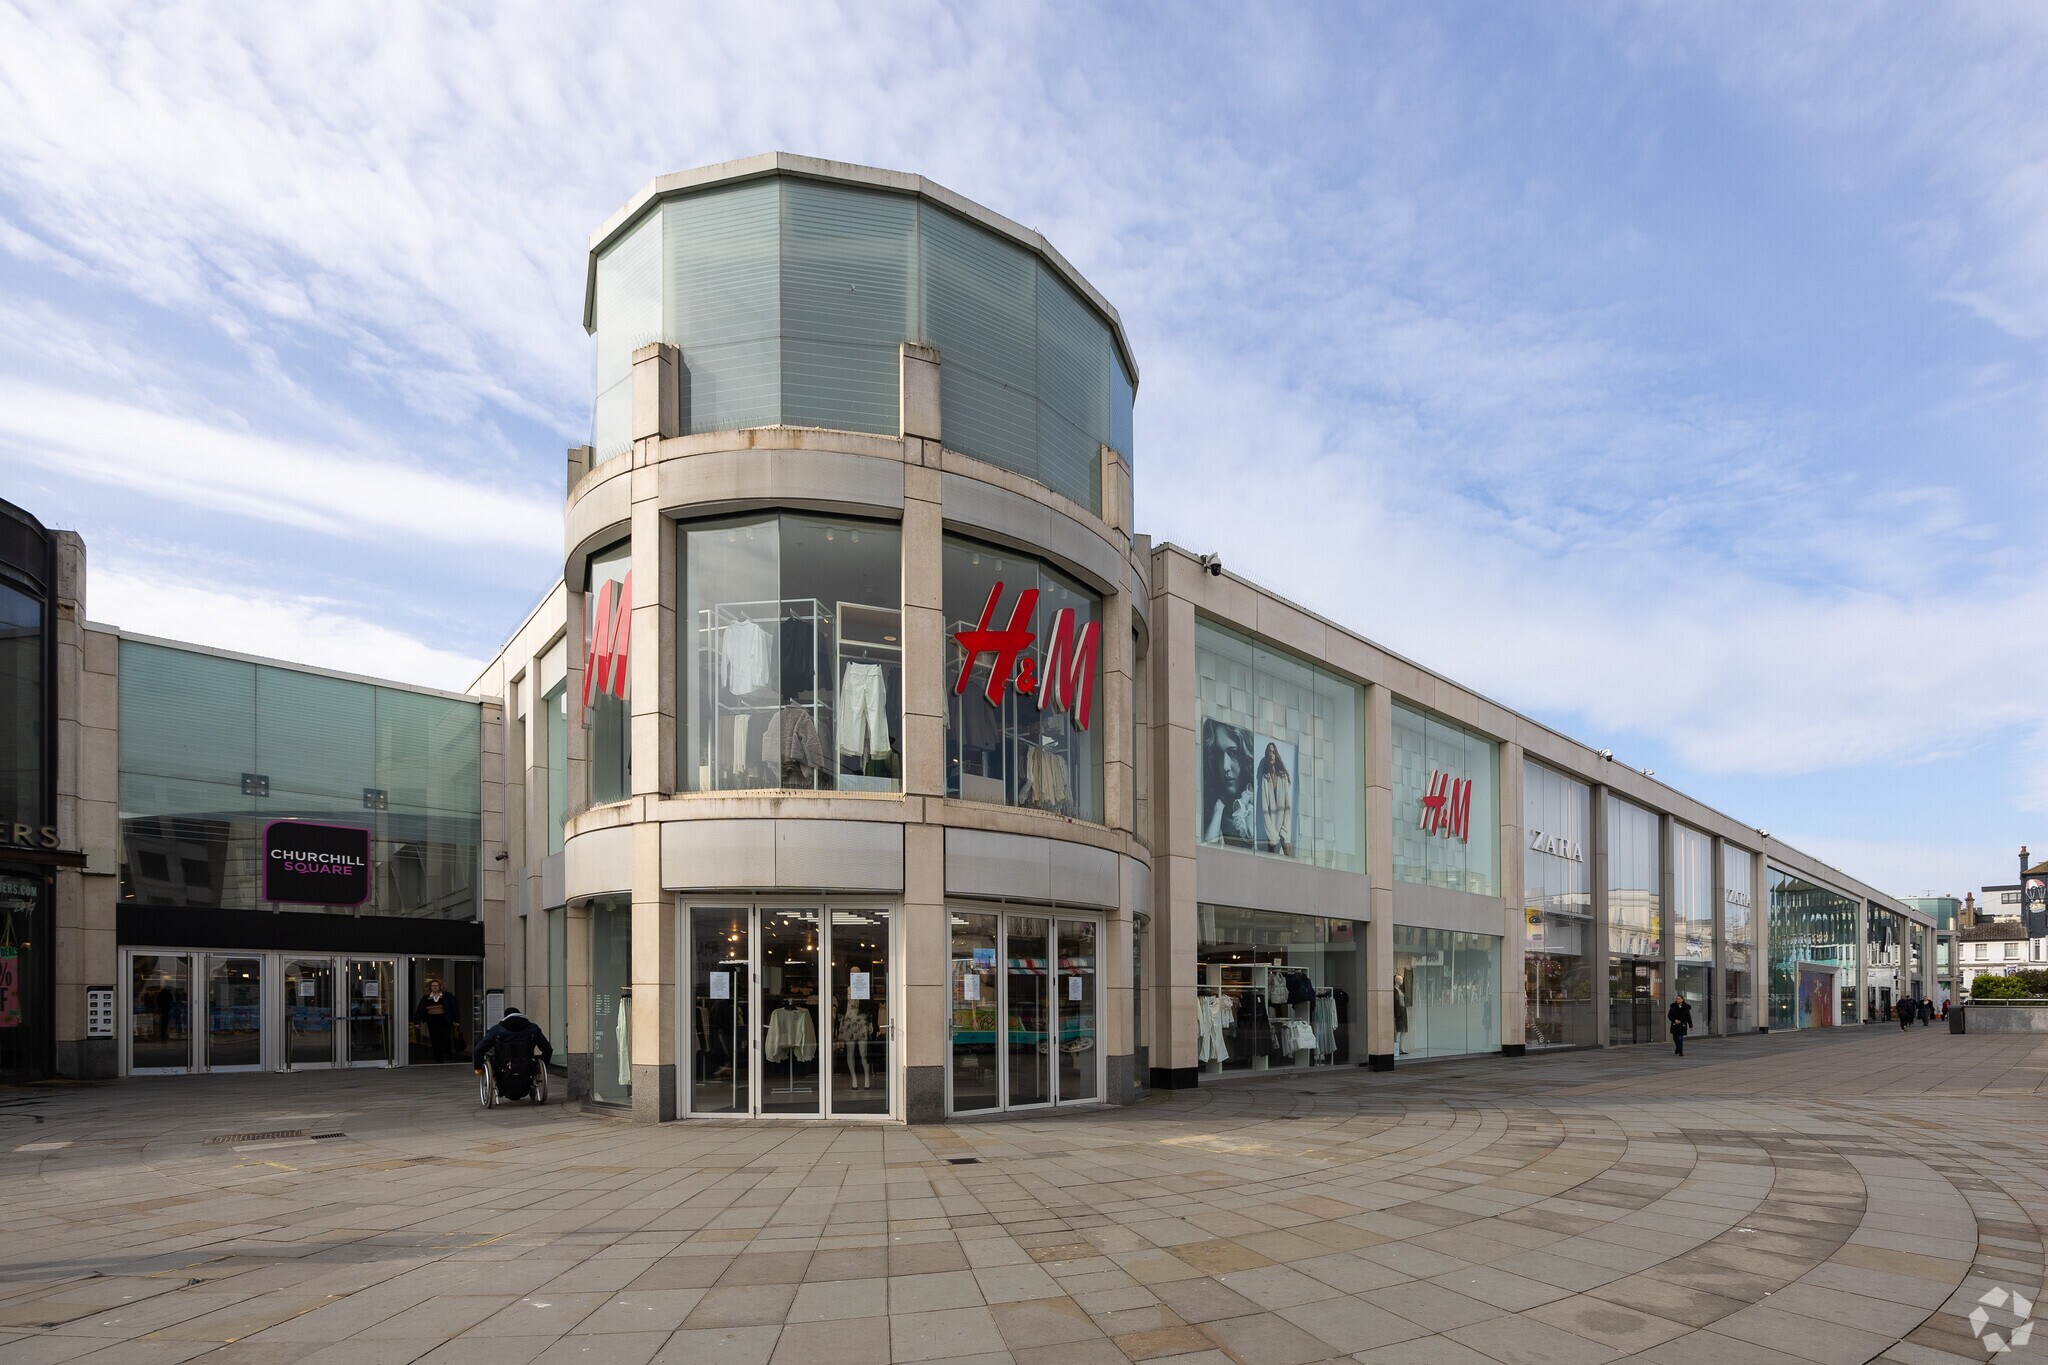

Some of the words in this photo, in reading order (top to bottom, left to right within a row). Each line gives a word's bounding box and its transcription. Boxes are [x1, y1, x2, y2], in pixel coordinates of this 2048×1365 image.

[954, 581, 1100, 731] H&M
[1418, 769, 1472, 845] H&M
[271, 849, 365, 866] CHURCHILL
[1530, 829, 1584, 863] ZARA
[284, 861, 353, 876] SQUARE
[1726, 888, 1751, 909] ZARA
